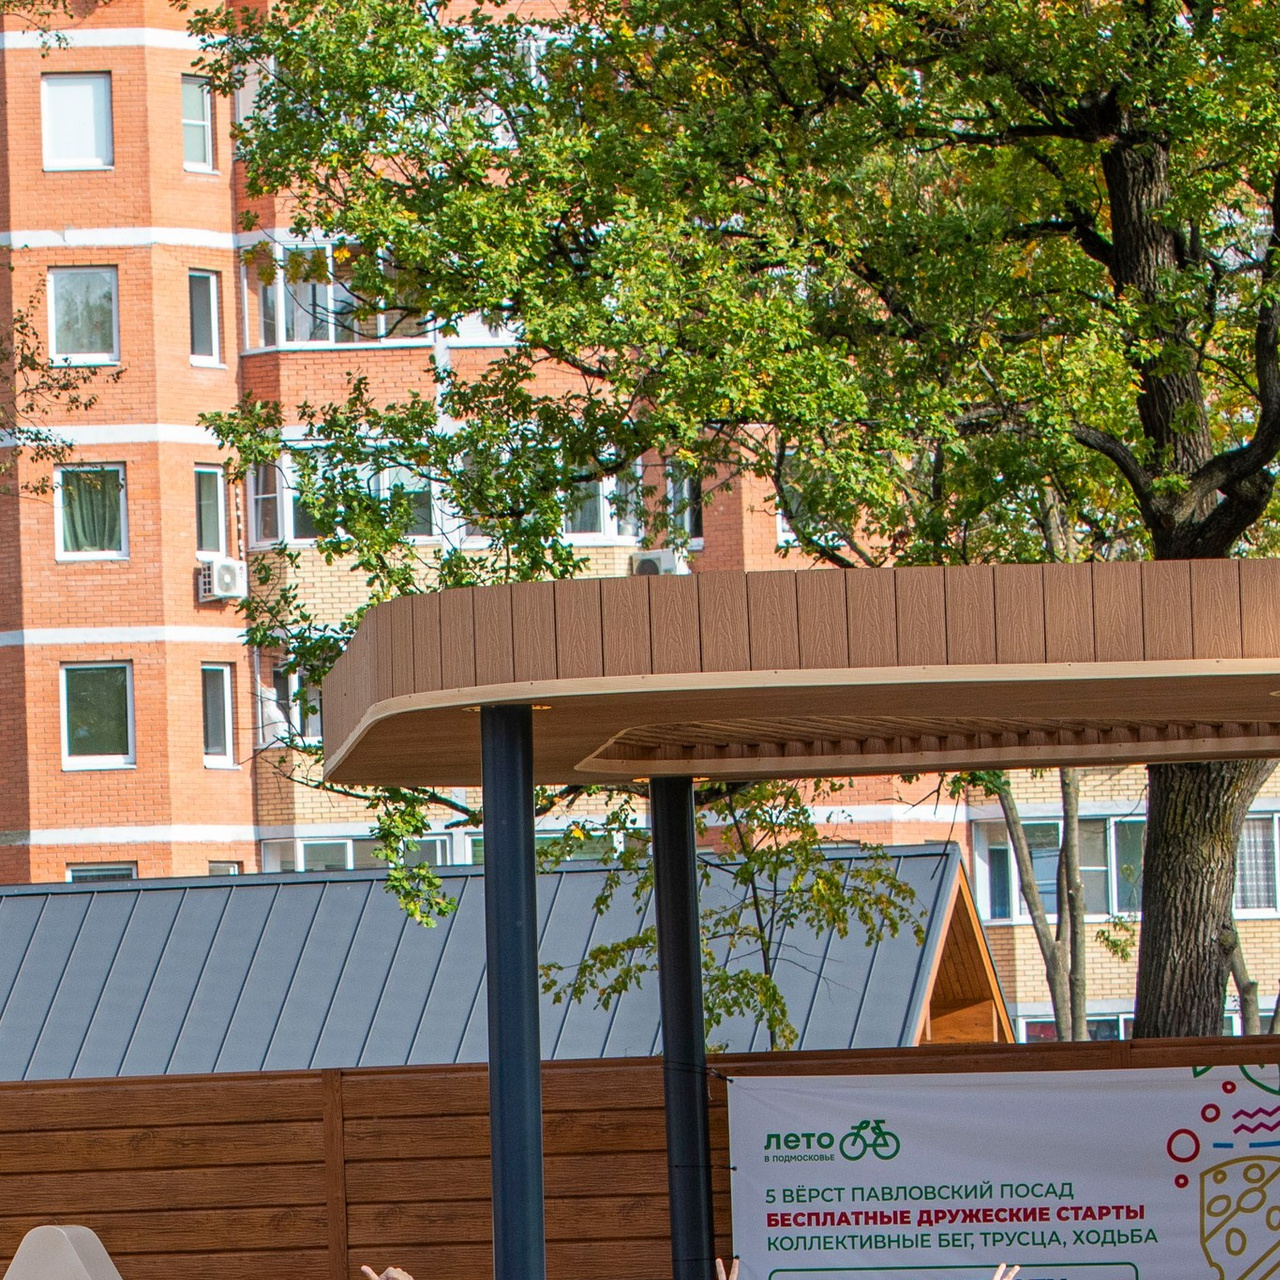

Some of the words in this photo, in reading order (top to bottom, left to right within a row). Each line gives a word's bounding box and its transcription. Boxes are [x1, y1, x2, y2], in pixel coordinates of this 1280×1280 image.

[772, 1154, 835, 1163] ПОДМОСКОВЬЕ
[765, 1189, 776, 1204] 5
[782, 1185, 845, 1203] ВЁРСТ
[852, 1181, 993, 1202] ПАВЛОВСКИЙ
[1000, 1182, 1074, 1200] ПОСАД
[767, 1210, 911, 1228] БЕСПЛАТНЫЕ
[917, 1207, 1050, 1227] ДРУЖЕСКИЕ
[1056, 1205, 1145, 1222] СТАРТЫ
[768, 1234, 931, 1252] КОЛЛЕКТИВНЫЕ
[938, 1233, 975, 1250] БЕГ,
[980, 1231, 1067, 1249] ТРУСЦА,
[1073, 1229, 1159, 1247] ХОДЬБА
